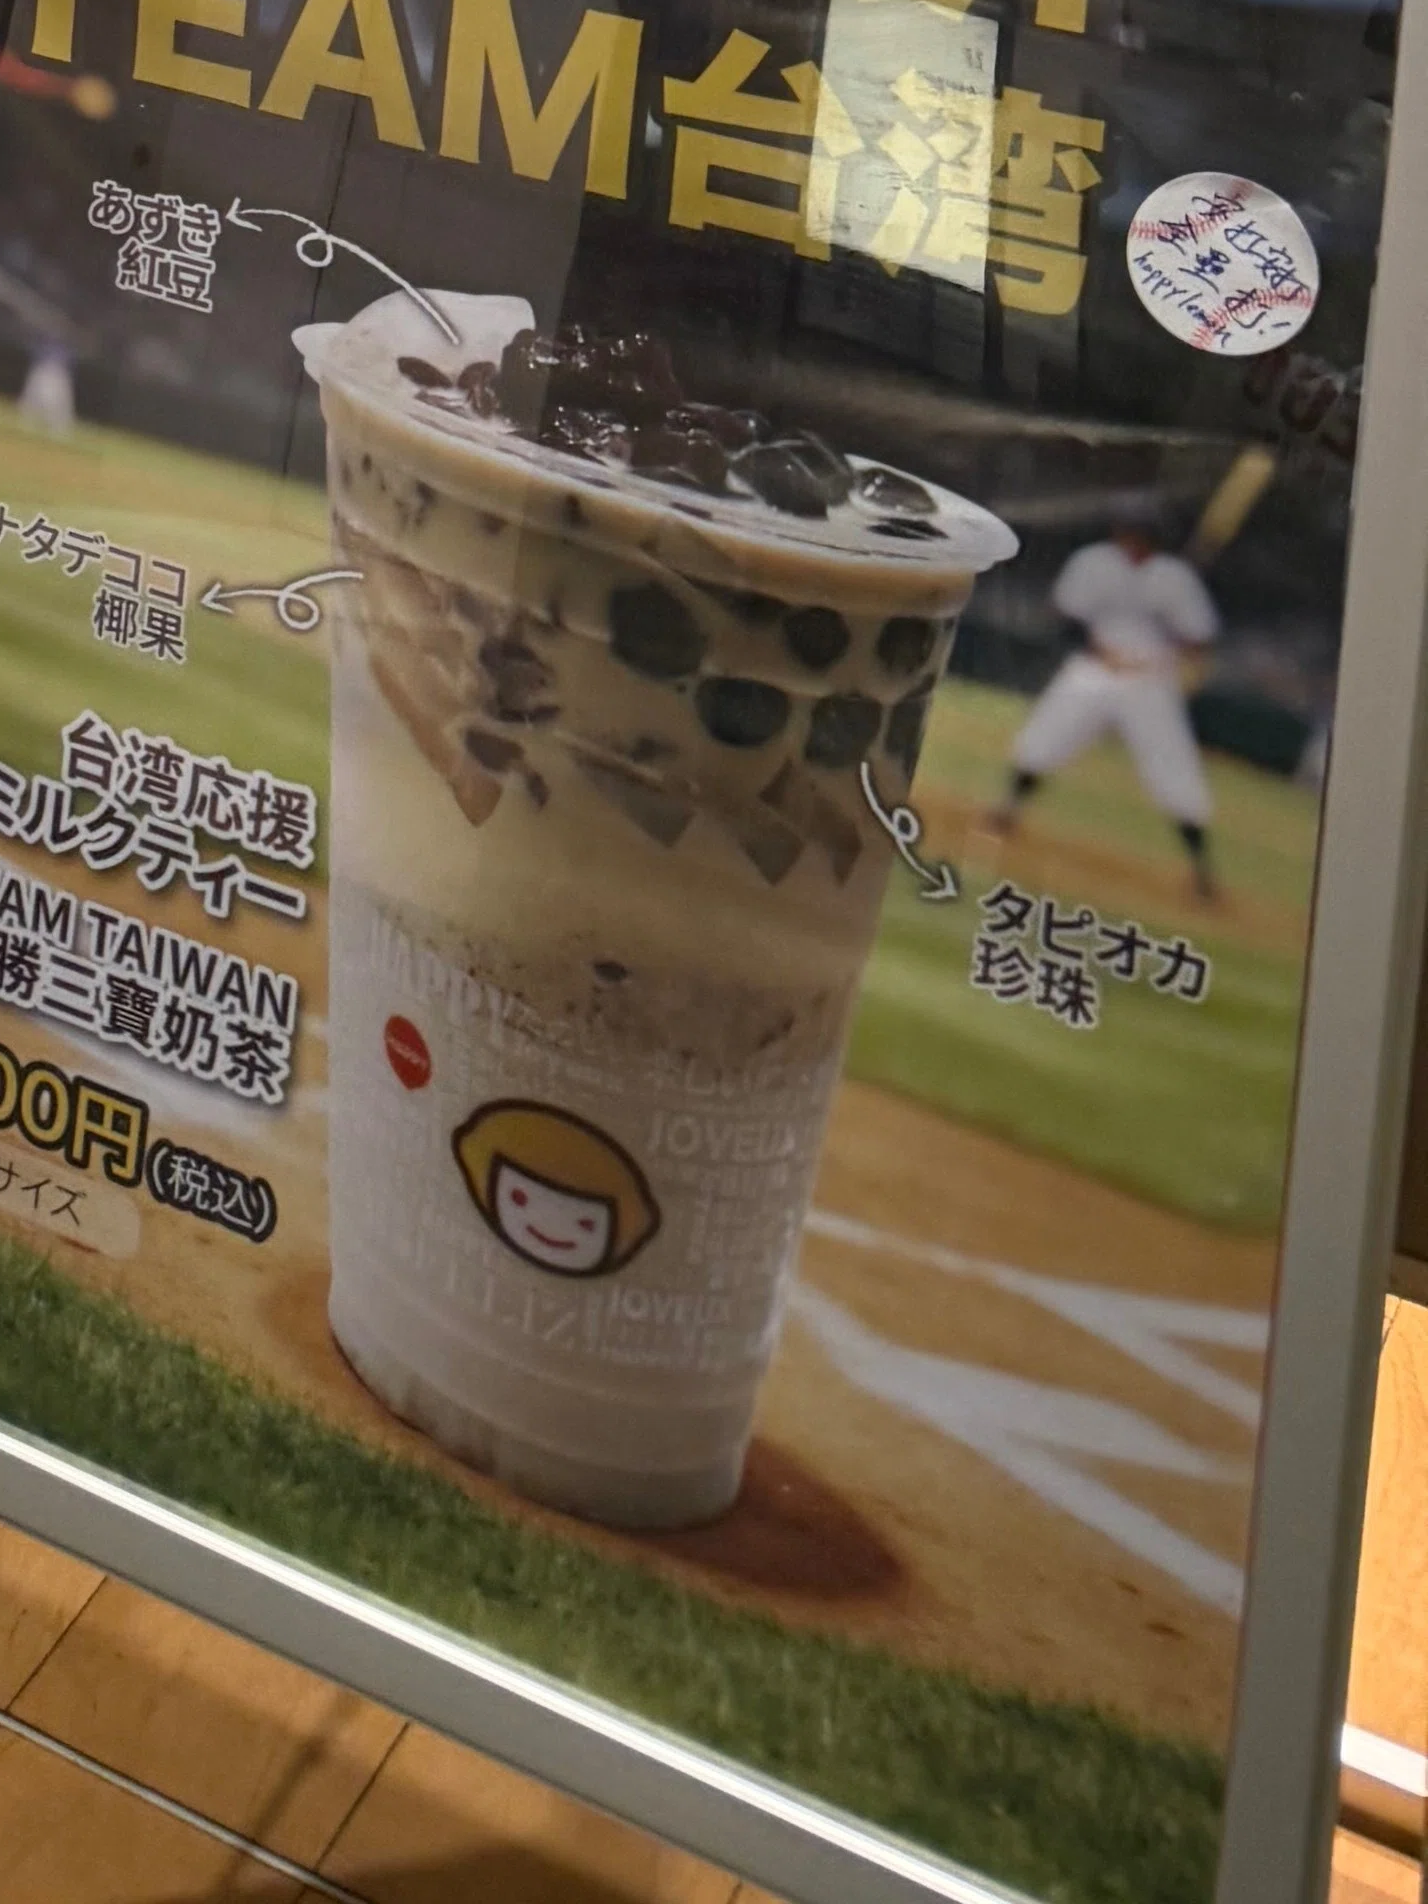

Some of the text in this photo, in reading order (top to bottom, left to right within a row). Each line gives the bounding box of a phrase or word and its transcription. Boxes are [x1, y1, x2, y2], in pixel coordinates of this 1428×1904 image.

[88, 180, 222, 256] あずき
[115, 239, 217, 314] 紅豆
[92, 589, 188, 665] 椰果
[61, 709, 317, 869] 台湾応援
[86, 902, 300, 1037] TAIWAN
[970, 935, 1101, 1030] 珍珠
[977, 882, 1212, 1005] タピオカ
